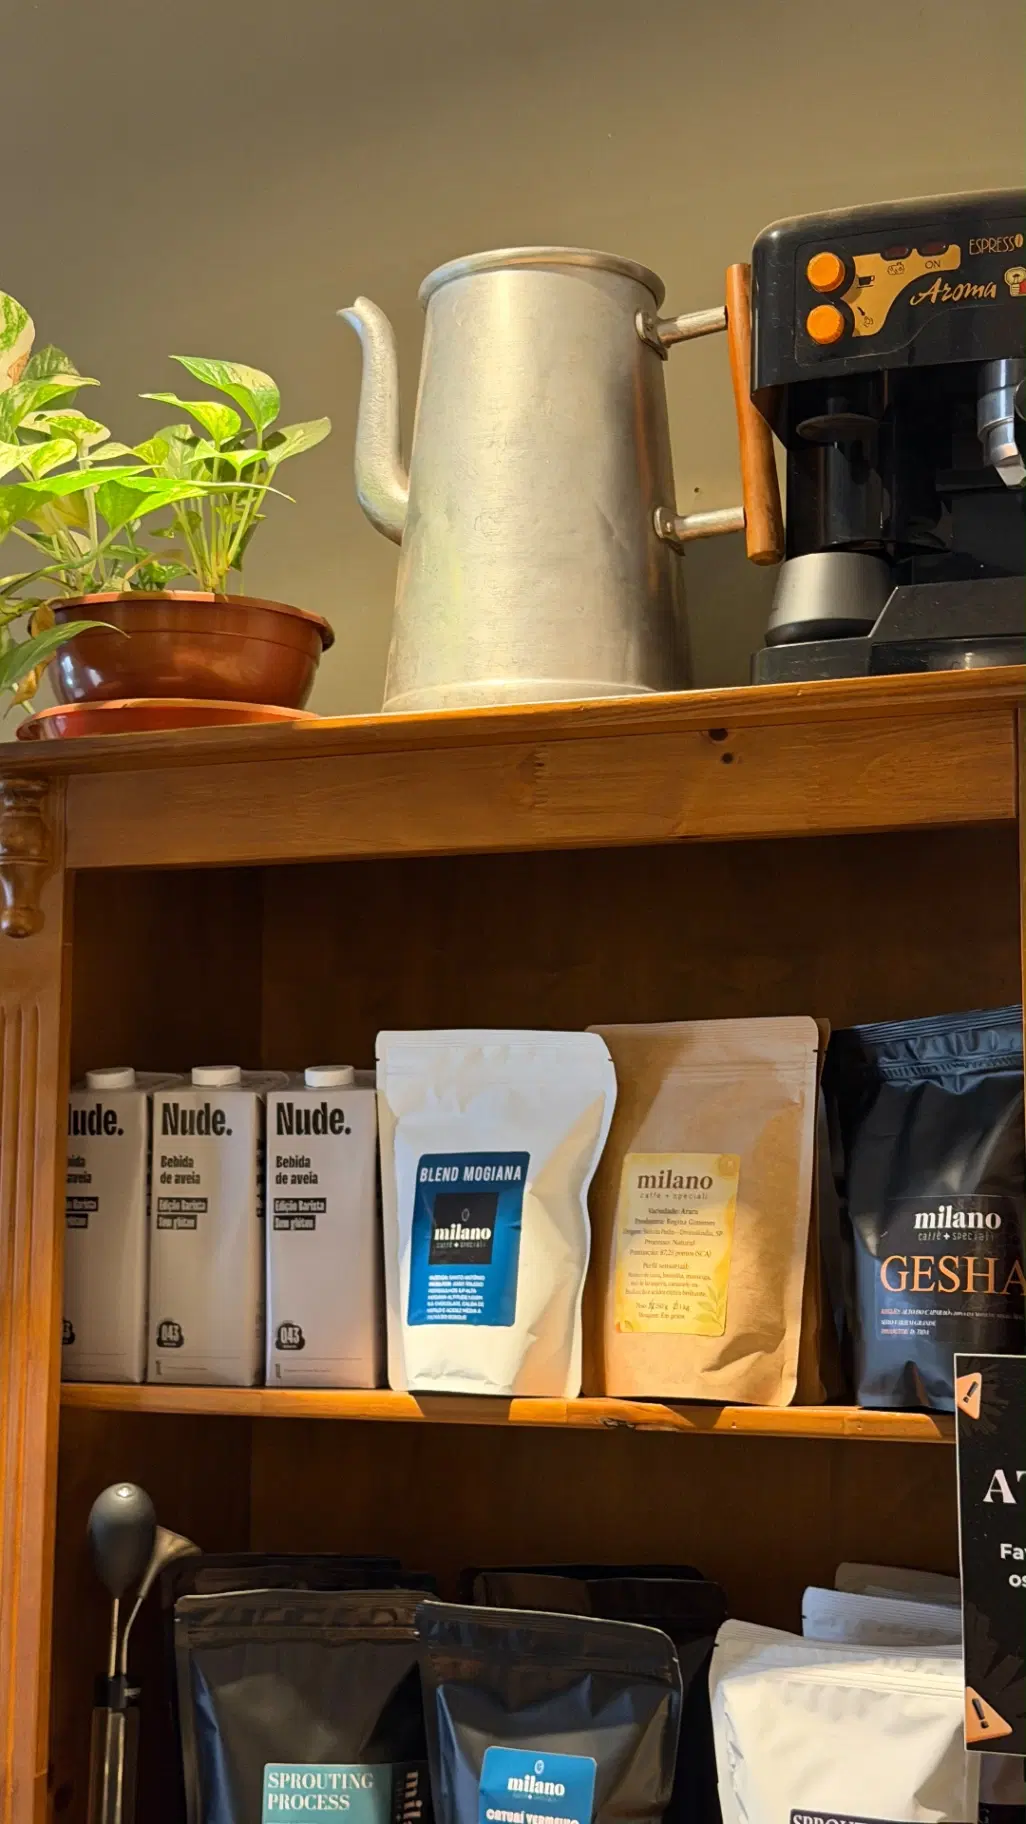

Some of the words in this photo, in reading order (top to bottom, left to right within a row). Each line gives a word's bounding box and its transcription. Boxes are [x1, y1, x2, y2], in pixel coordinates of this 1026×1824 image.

[925, 260, 942, 270] ON
[909, 277, 997, 306] Aroma
[161, 1102, 233, 1136] Nude.
[276, 1102, 352, 1135] Nude.
[160, 1155, 194, 1168] Bebida
[275, 1155, 311, 1168] Bebida
[160, 1172, 172, 1184] de
[174, 1171, 201, 1184] aveia
[275, 1172, 288, 1184] de
[290, 1171, 318, 1184] aveia
[420, 1167, 459, 1182] BLEND
[463, 1166, 521, 1181] MOGIANA
[637, 1169, 714, 1189] milano
[914, 1205, 1001, 1229] milano
[434, 1223, 491, 1240] milano
[880, 1255, 1026, 1296] GESHA
[983, 1469, 1026, 1504] A
[268, 1773, 373, 1788] SPROUTING
[507, 1775, 565, 1796] milano
[268, 1794, 350, 1810] PROCESS
